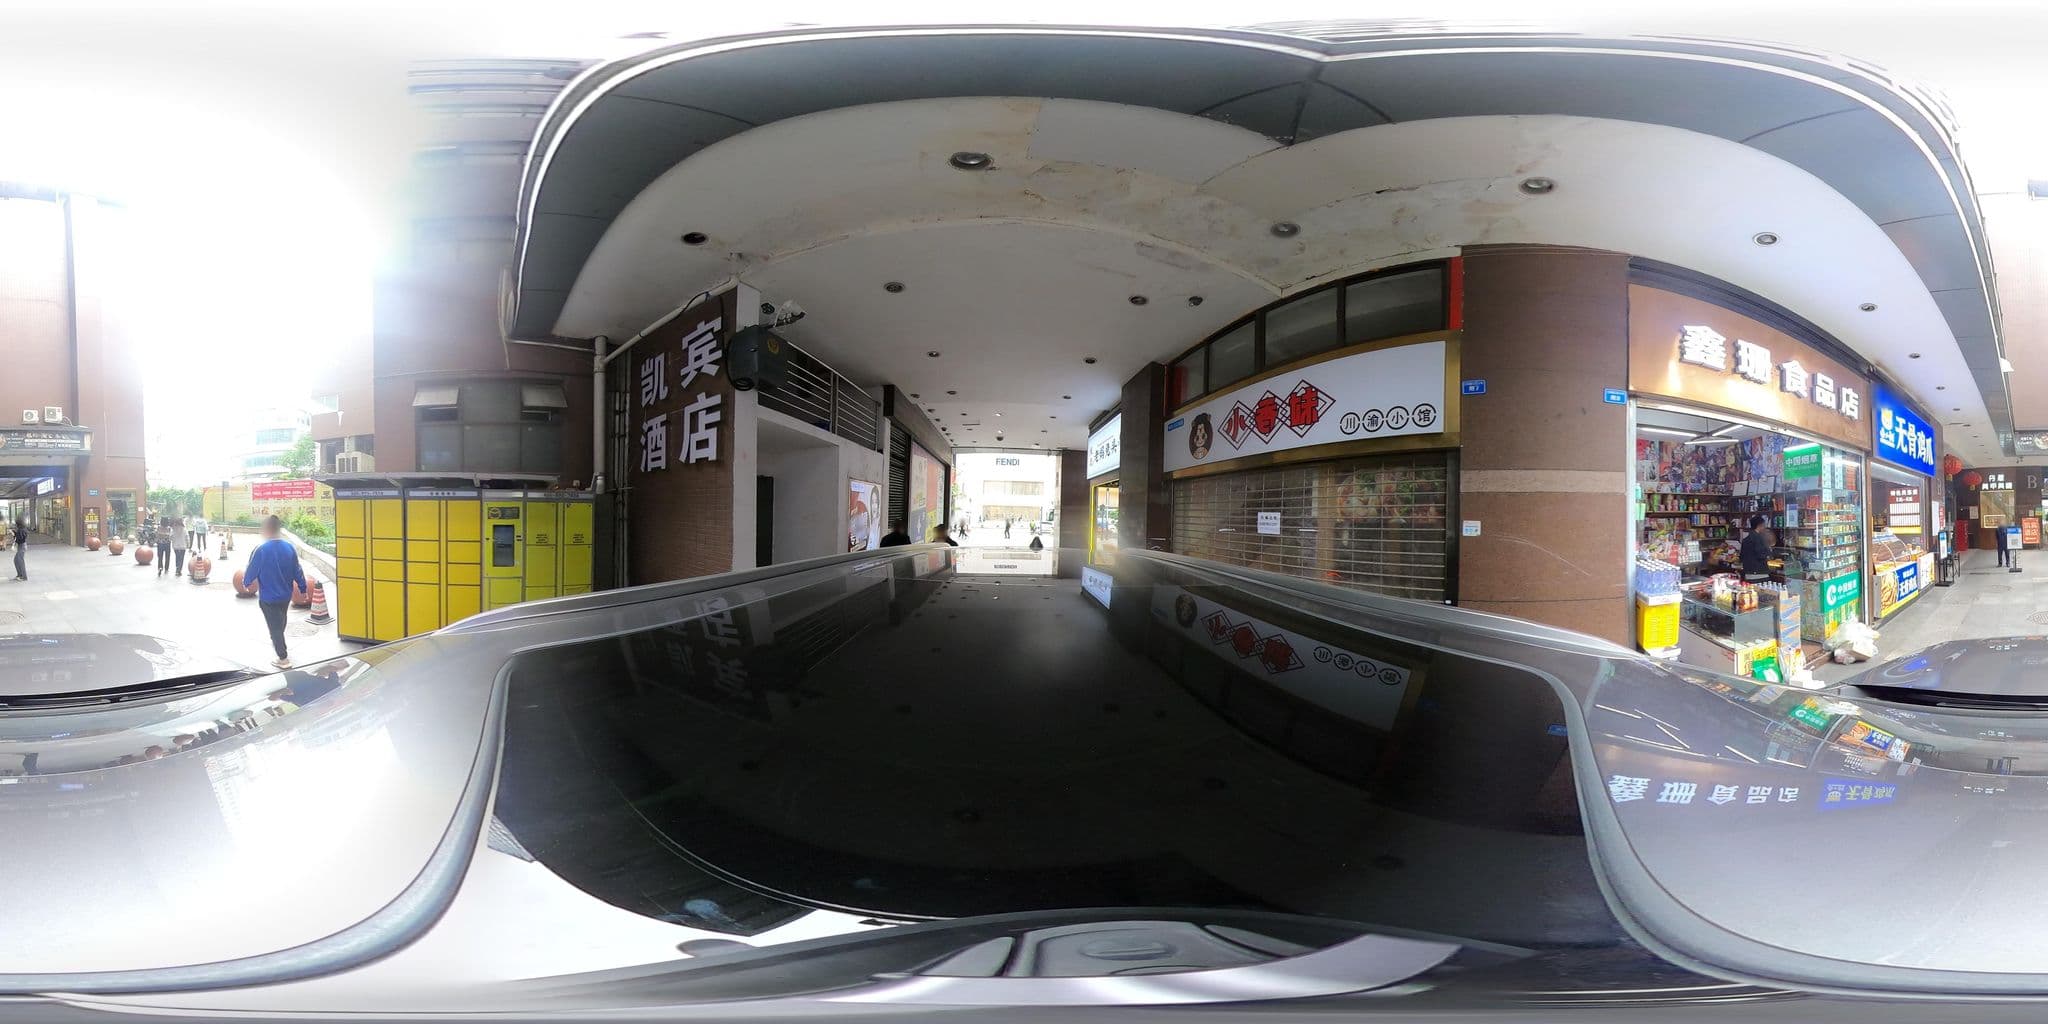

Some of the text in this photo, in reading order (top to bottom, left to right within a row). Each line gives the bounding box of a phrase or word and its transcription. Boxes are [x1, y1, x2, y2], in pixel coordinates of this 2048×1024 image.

[640, 317, 724, 407] 凯宾
[1679, 325, 1860, 421] 鑫珊食品店
[640, 393, 722, 473] 酒店
[1343, 408, 1433, 430] 川渝小馆
[1895, 416, 1934, 466] 无骨鸡爪
[995, 458, 1020, 466] FENDI
[2027, 475, 2038, 489] B
